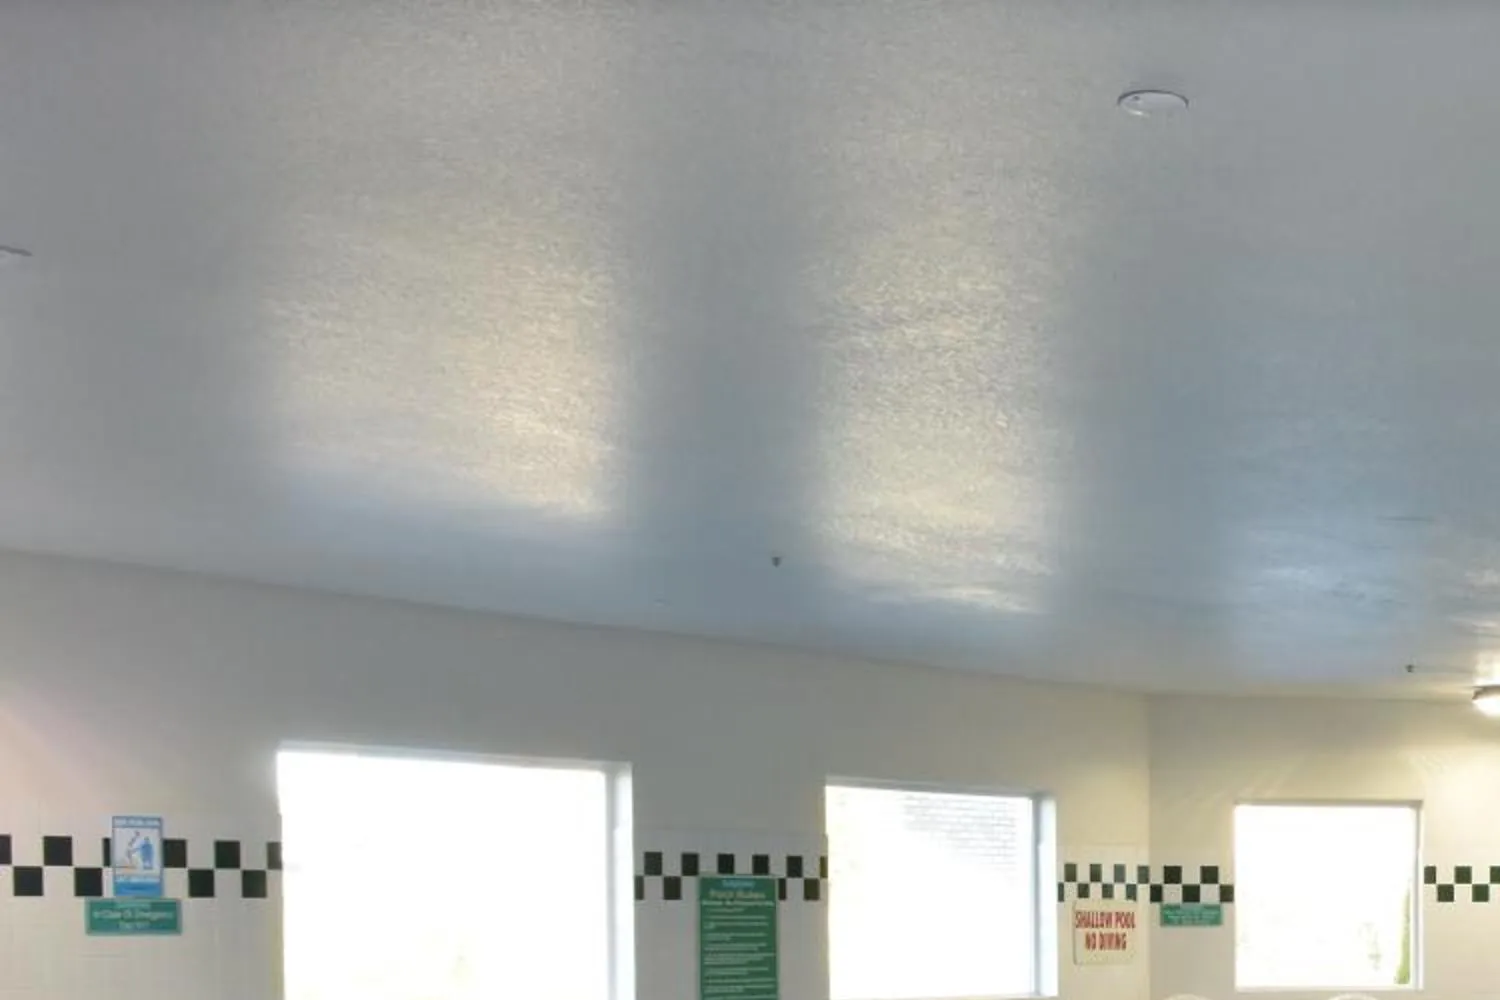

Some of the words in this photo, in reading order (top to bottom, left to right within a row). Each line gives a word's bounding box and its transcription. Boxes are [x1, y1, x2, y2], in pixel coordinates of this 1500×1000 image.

[1075, 911, 1113, 929] SHALLOW
[1115, 911, 1136, 929] POOL
[1085, 932, 1097, 950] NO
[1099, 932, 1127, 950] DIVING
